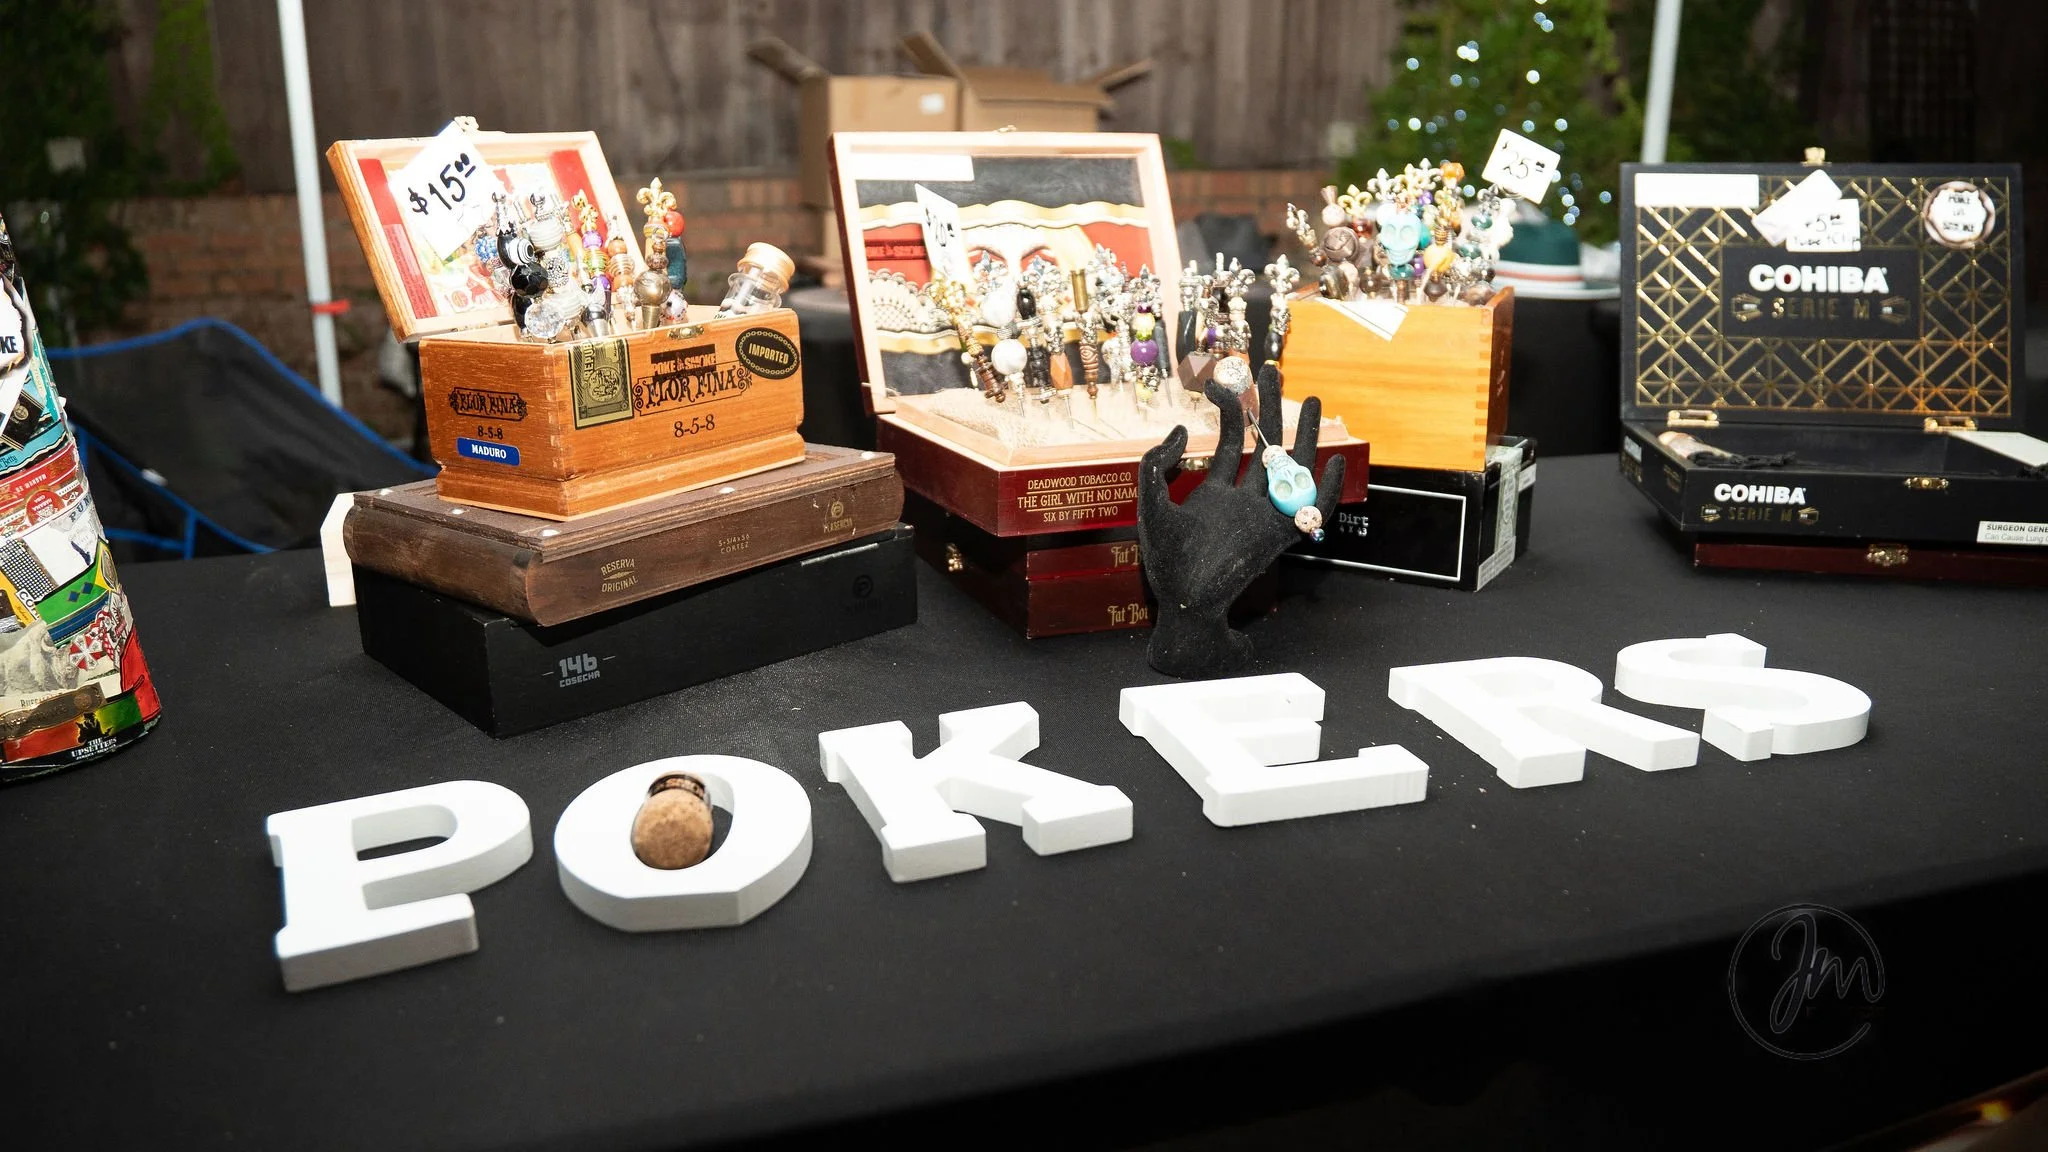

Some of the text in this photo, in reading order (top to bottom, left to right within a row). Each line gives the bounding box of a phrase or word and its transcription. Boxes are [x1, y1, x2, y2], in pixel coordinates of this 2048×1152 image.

[1749, 264, 1889, 294] COHIBA
[1772, 297, 1870, 320] SERIE M
[749, 342, 790, 365] IMPORTED
[652, 360, 677, 377] POKE
[684, 354, 717, 371] SMOKE
[646, 365, 739, 408] FLOR FINA
[477, 425, 504, 440] 8-5-8
[674, 413, 716, 438] 8-5-8
[471, 443, 507, 459] MADURO
[1028, 476, 1077, 490] DEADWOOD
[1079, 472, 1118, 486] TOBACCO
[1017, 486, 1137, 509] THE GIRL WITH NO NAM
[1714, 482, 1807, 505] COHIBA
[1043, 505, 1118, 523] SIX BY FIFTY TWO
[1339, 511, 1369, 527] Dirt
[1728, 506, 1772, 520] SERIE
[1782, 507, 1793, 521] M
[1986, 523, 2026, 532] SURGEON
[1984, 532, 2000, 541] Can
[2001, 533, 2024, 541] Cause
[2025, 534, 2044, 544] Lung
[720, 541, 750, 555] CORTEZ
[1111, 543, 1141, 568] Fat B
[600, 557, 636, 576] RESERVA
[601, 575, 639, 593] ORIGINAL
[1107, 605, 1126, 627] Fat
[559, 670, 602, 689] COSECHA
[88, 737, 103, 747] THE
[265, 632, 1872, 990] POKERS
